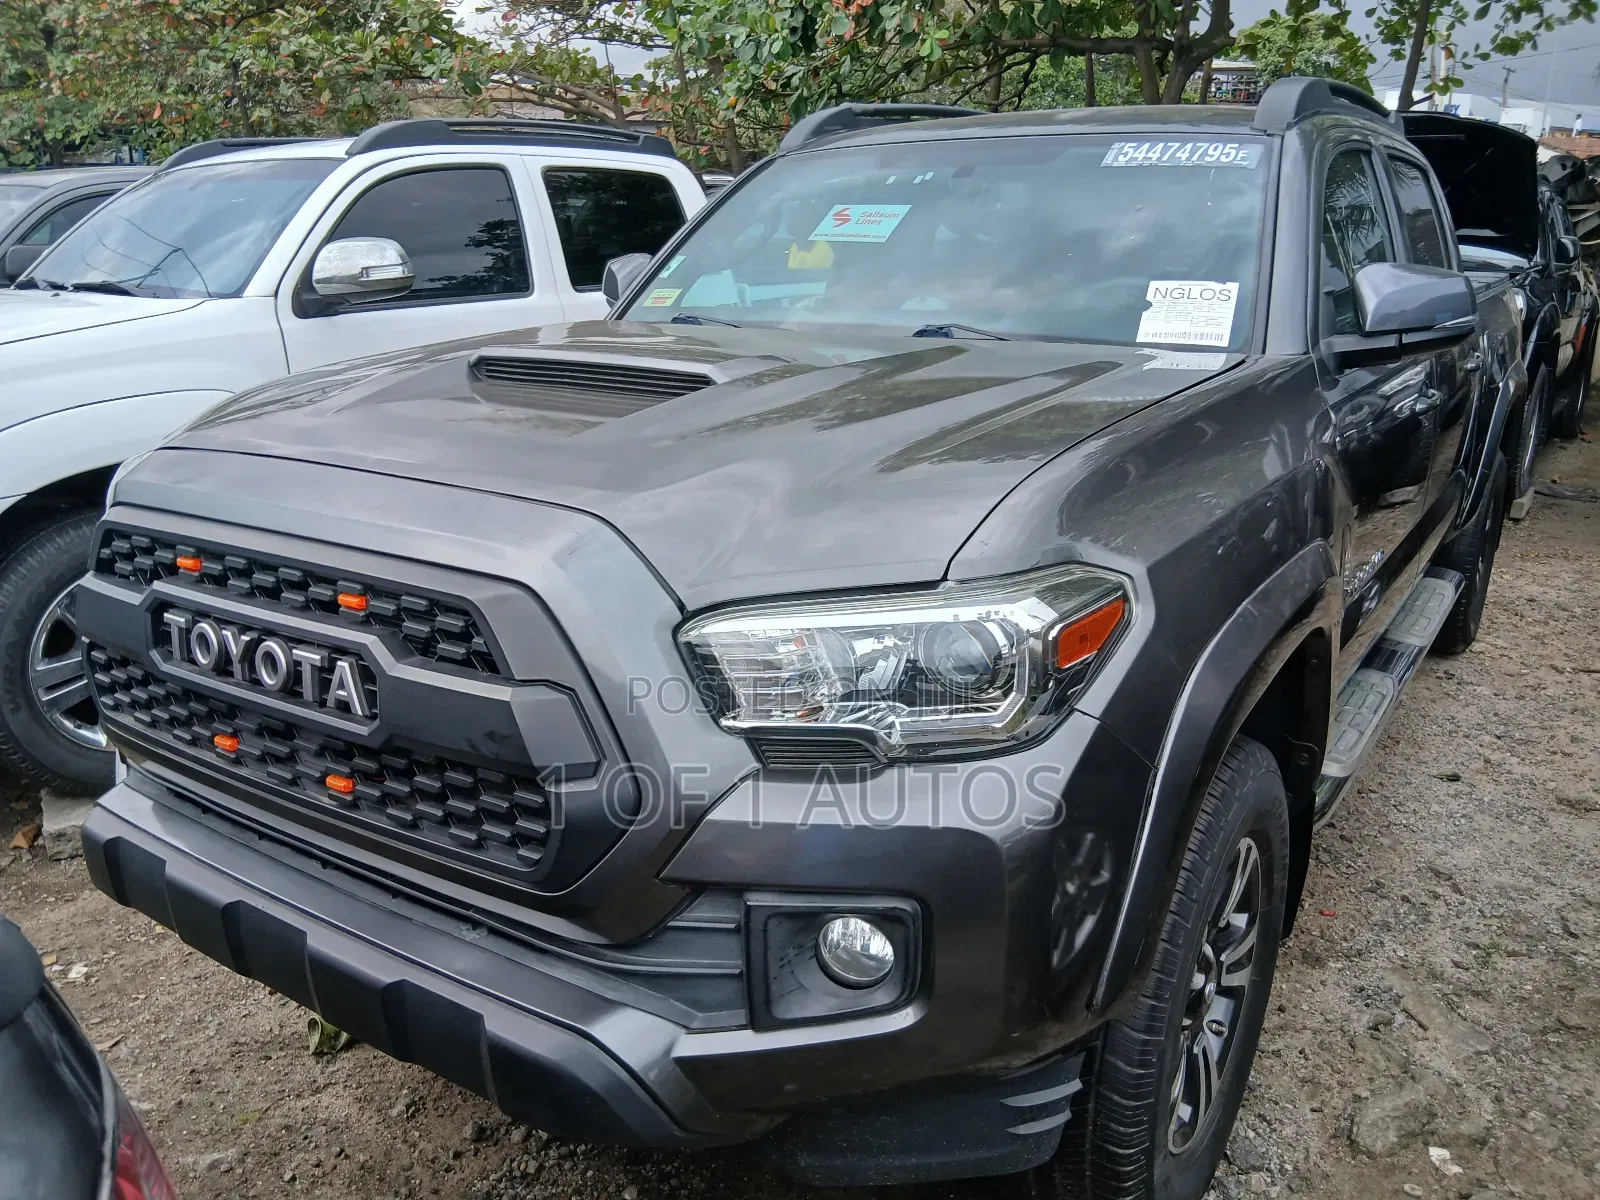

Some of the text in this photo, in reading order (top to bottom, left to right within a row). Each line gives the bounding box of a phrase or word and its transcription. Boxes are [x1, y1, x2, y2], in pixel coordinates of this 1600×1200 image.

[859, 211, 900, 219] Sallaum
[1153, 287, 1232, 302] NGLOS
[163, 610, 371, 717] TOYOTA
